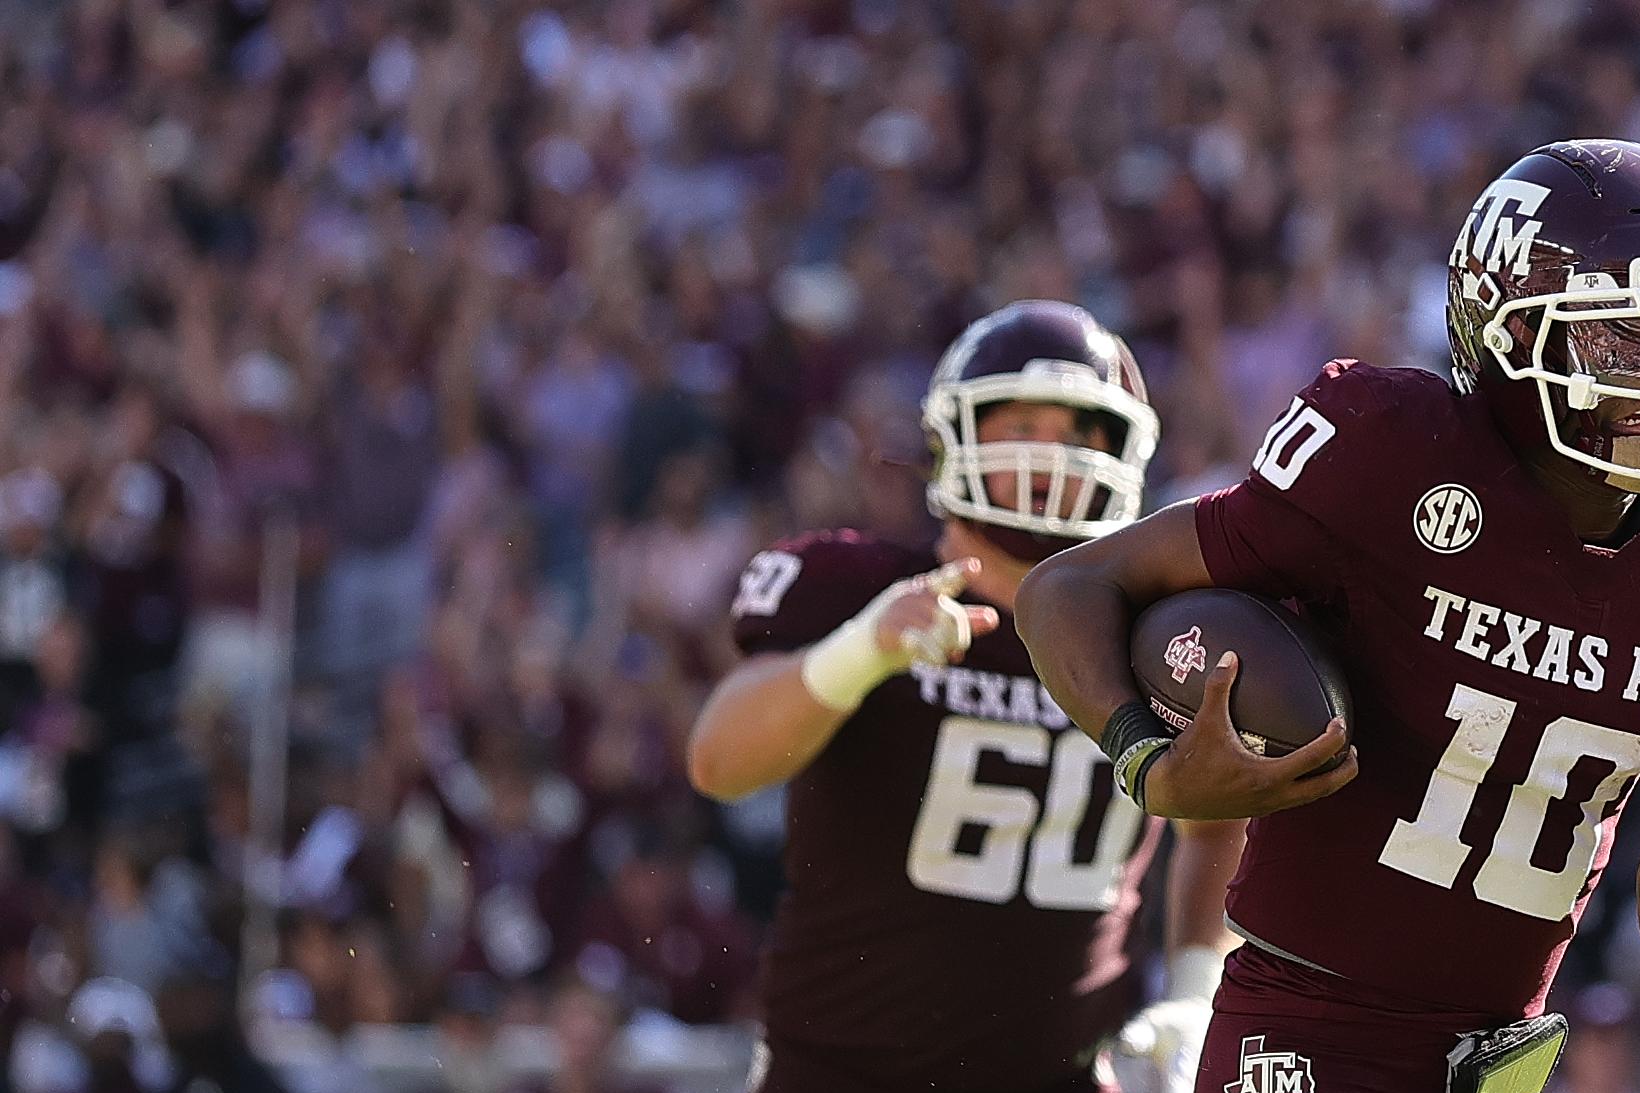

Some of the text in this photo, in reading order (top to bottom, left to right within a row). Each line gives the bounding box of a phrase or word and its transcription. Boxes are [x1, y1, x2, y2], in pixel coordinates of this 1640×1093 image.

[1252, 395, 1336, 491] 10
[1418, 491, 1478, 547] SEC
[1423, 585, 1608, 692] TEXAS
[906, 715, 1143, 912] 60
